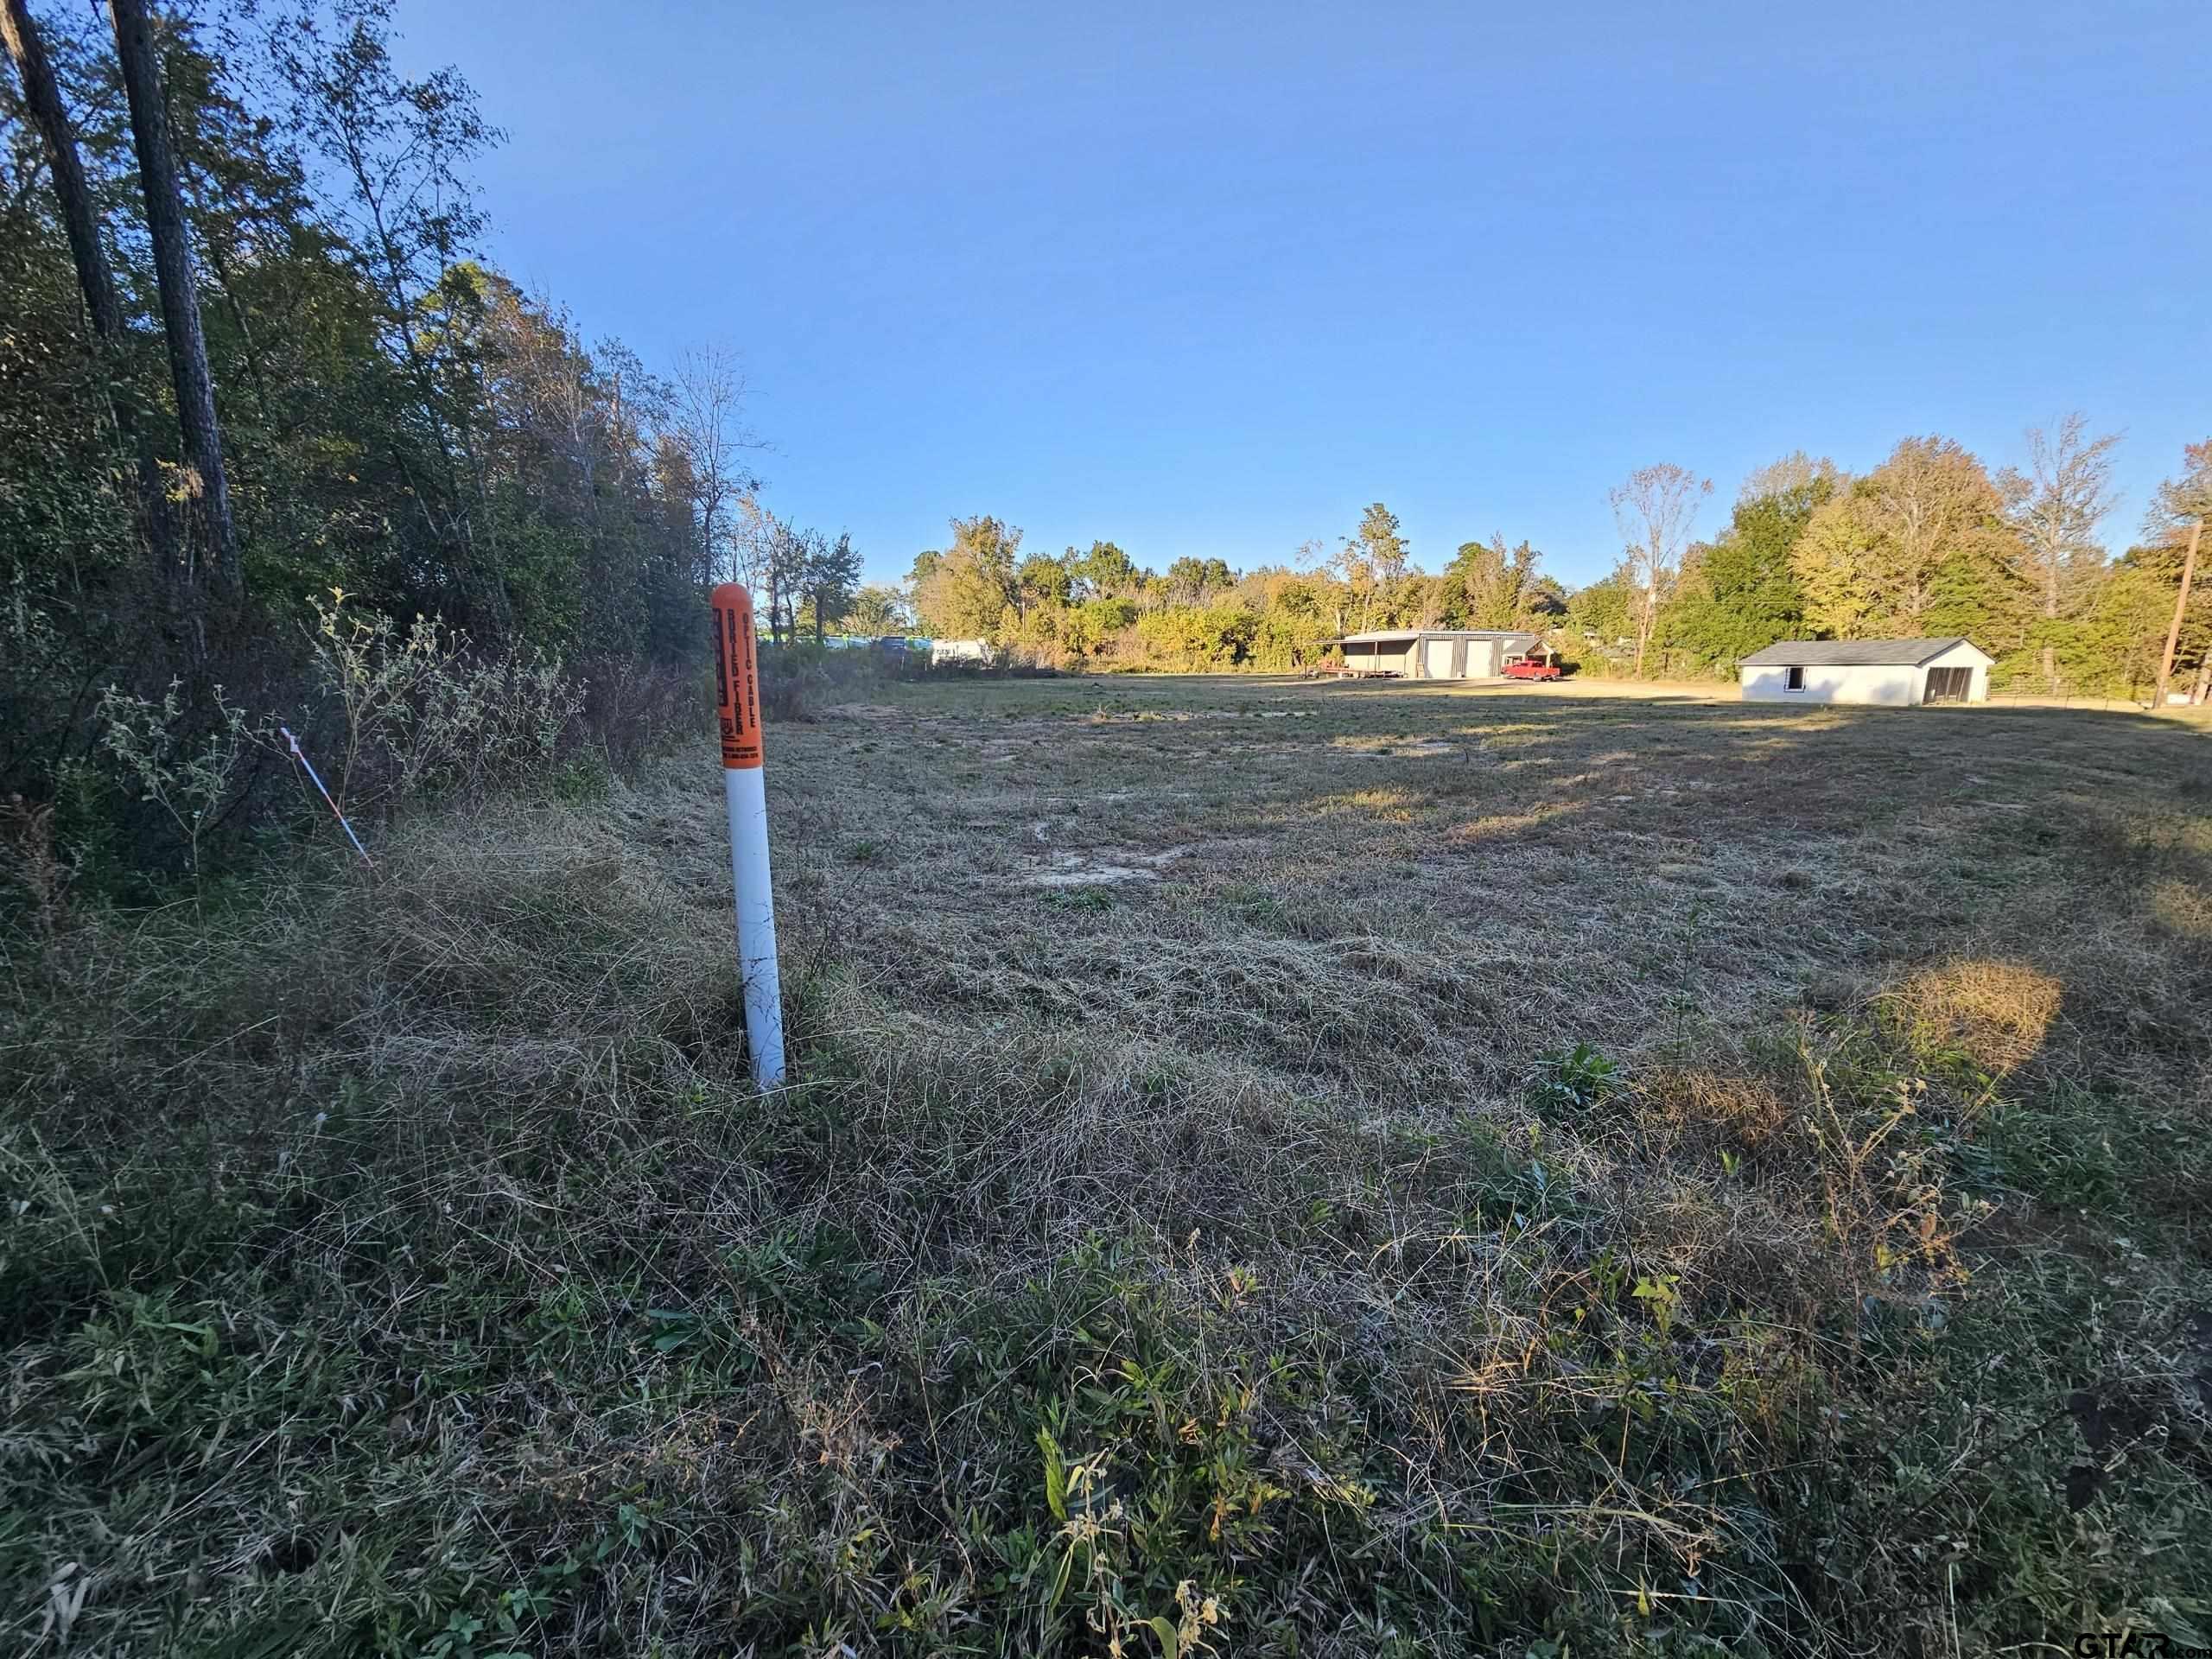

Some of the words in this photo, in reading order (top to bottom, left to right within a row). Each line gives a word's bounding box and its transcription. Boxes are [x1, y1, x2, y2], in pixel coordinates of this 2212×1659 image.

[728, 609, 740, 677] BURIED
[742, 613, 752, 671] OPTIC
[747, 674, 756, 728] CABLE
[733, 680, 744, 735] FIBER
